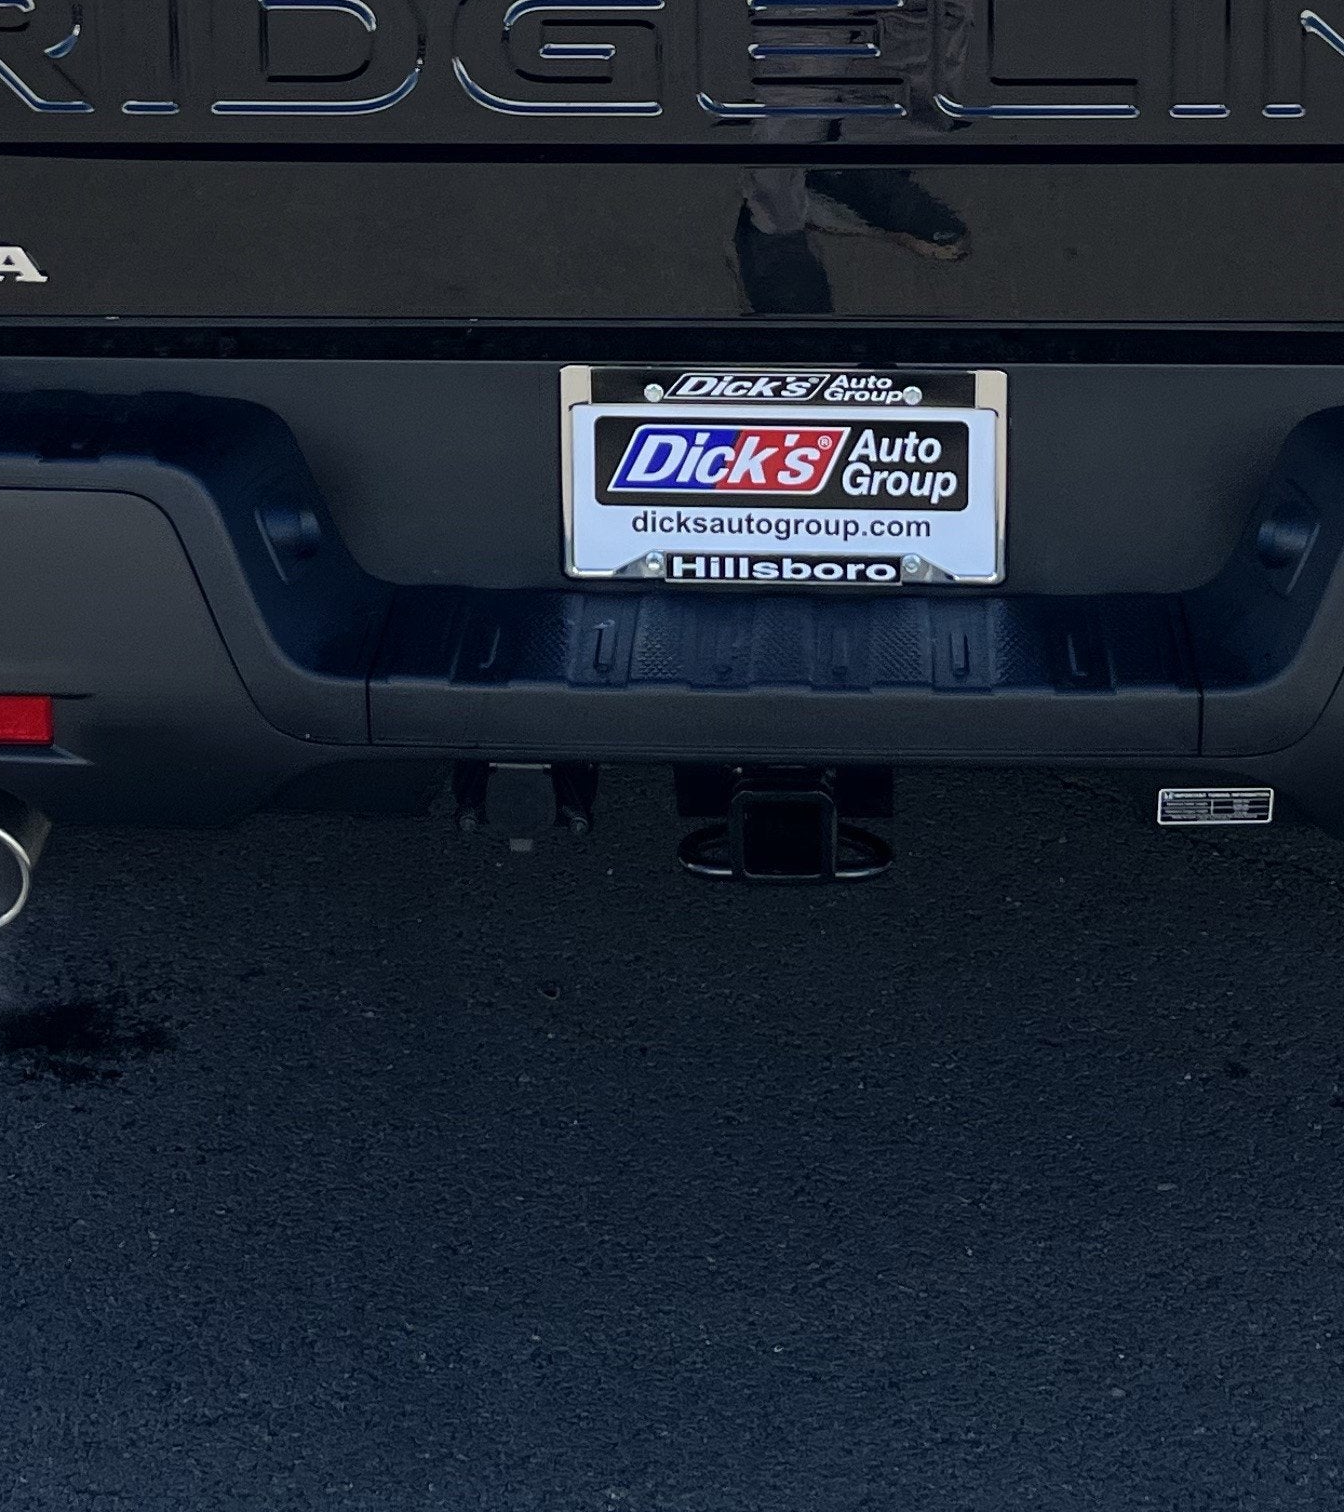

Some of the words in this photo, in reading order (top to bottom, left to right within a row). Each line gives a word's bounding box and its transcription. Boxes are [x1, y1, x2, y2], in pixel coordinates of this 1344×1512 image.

[676, 375, 813, 397] Dick's
[829, 375, 893, 389] Auto
[824, 387, 903, 404] Group
[627, 432, 821, 484] Dick's
[849, 430, 941, 463] Auto
[843, 464, 957, 503] Group
[632, 512, 931, 541] dicksautogroup.com
[673, 558, 897, 580] Hillsboro
